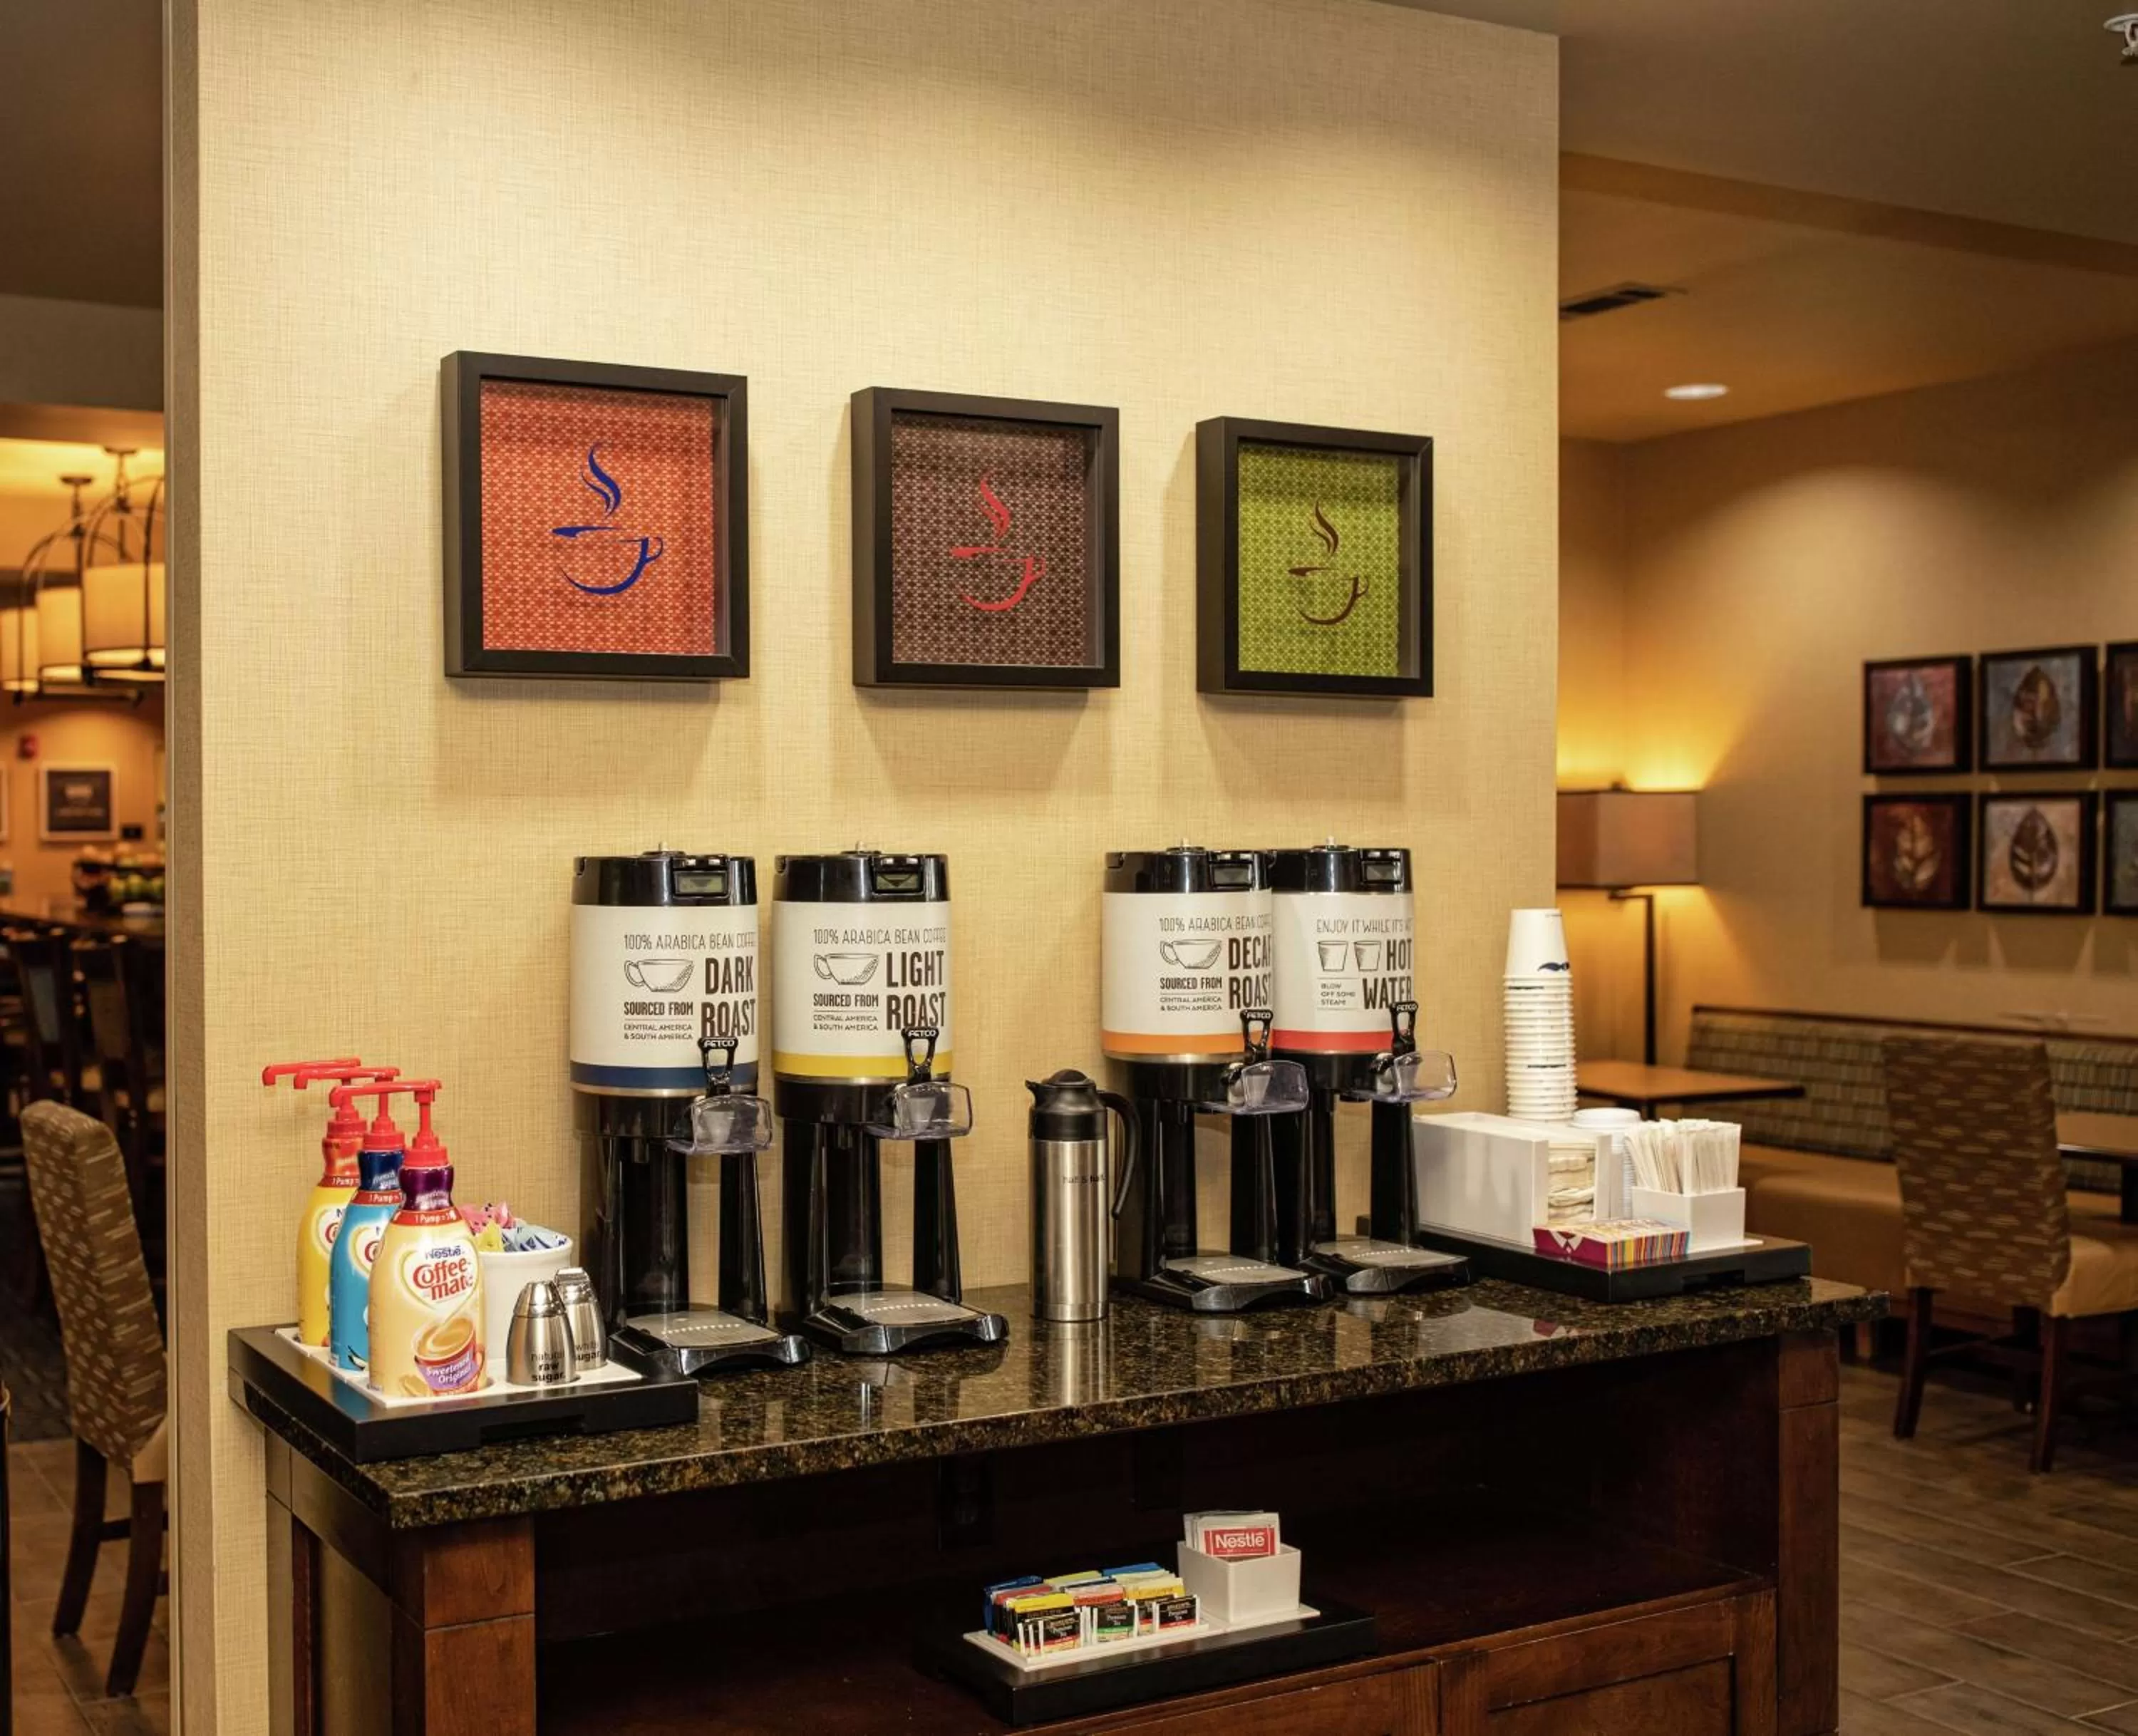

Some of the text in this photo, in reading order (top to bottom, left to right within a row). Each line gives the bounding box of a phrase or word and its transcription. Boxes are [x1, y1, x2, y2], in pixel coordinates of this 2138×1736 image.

[1159, 917, 1185, 931] 100%
[1188, 917, 1232, 931] ARABICA
[1235, 915, 1254, 930] BEAN
[1317, 919, 1348, 934] ENJOY
[1352, 919, 1360, 933] IT
[1362, 919, 1391, 933] WHILE
[624, 934, 652, 950] 100%
[656, 934, 706, 950] ARABICA
[710, 933, 733, 950] BEAN
[813, 929, 839, 944] 100%
[842, 929, 892, 944] ARABICA
[894, 929, 920, 944] BEAN
[1386, 939, 1412, 971] HOT
[705, 956, 754, 995] DARK
[886, 950, 945, 988] LIGHT
[1160, 976, 1222, 990] SOURCED FROM
[813, 993, 879, 1007] SOURCED FROM
[1363, 976, 1412, 1010] WATER
[624, 1001, 693, 1016] SOURCED FROM
[886, 992, 946, 1030] ROAST
[701, 999, 756, 1038] ROAST
[336, 1177, 354, 1187] Pump
[373, 1194, 393, 1204] Pump
[420, 1214, 440, 1224] Pump
[425, 1245, 462, 1259] Nestlé
[431, 1275, 473, 1301] mate
[427, 1350, 470, 1377] Sweetened
[539, 1362, 559, 1370] raw
[438, 1364, 471, 1384] Original
[1214, 1530, 1266, 1549] Nestlé
